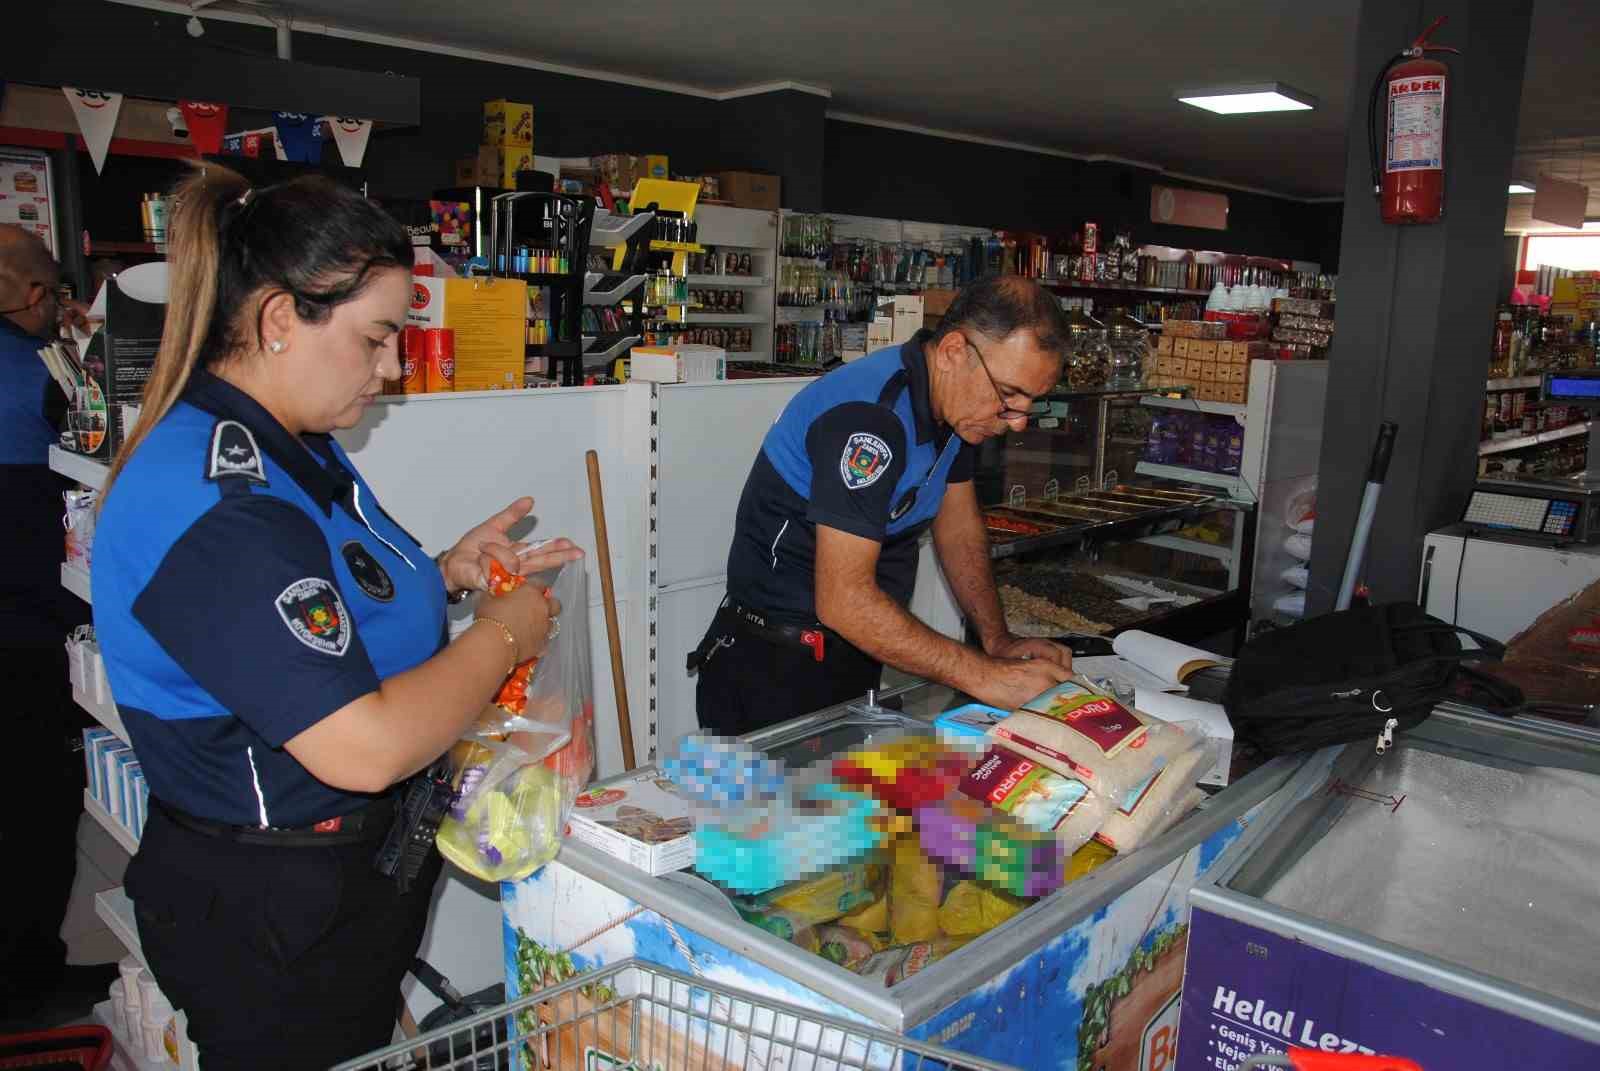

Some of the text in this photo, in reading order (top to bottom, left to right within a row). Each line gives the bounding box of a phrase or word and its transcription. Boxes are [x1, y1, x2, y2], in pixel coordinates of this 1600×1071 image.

[991, 760, 1032, 801] DURU
[1212, 986, 1376, 1057] Helal Lez
[1218, 1024, 1257, 1052] Geniş
